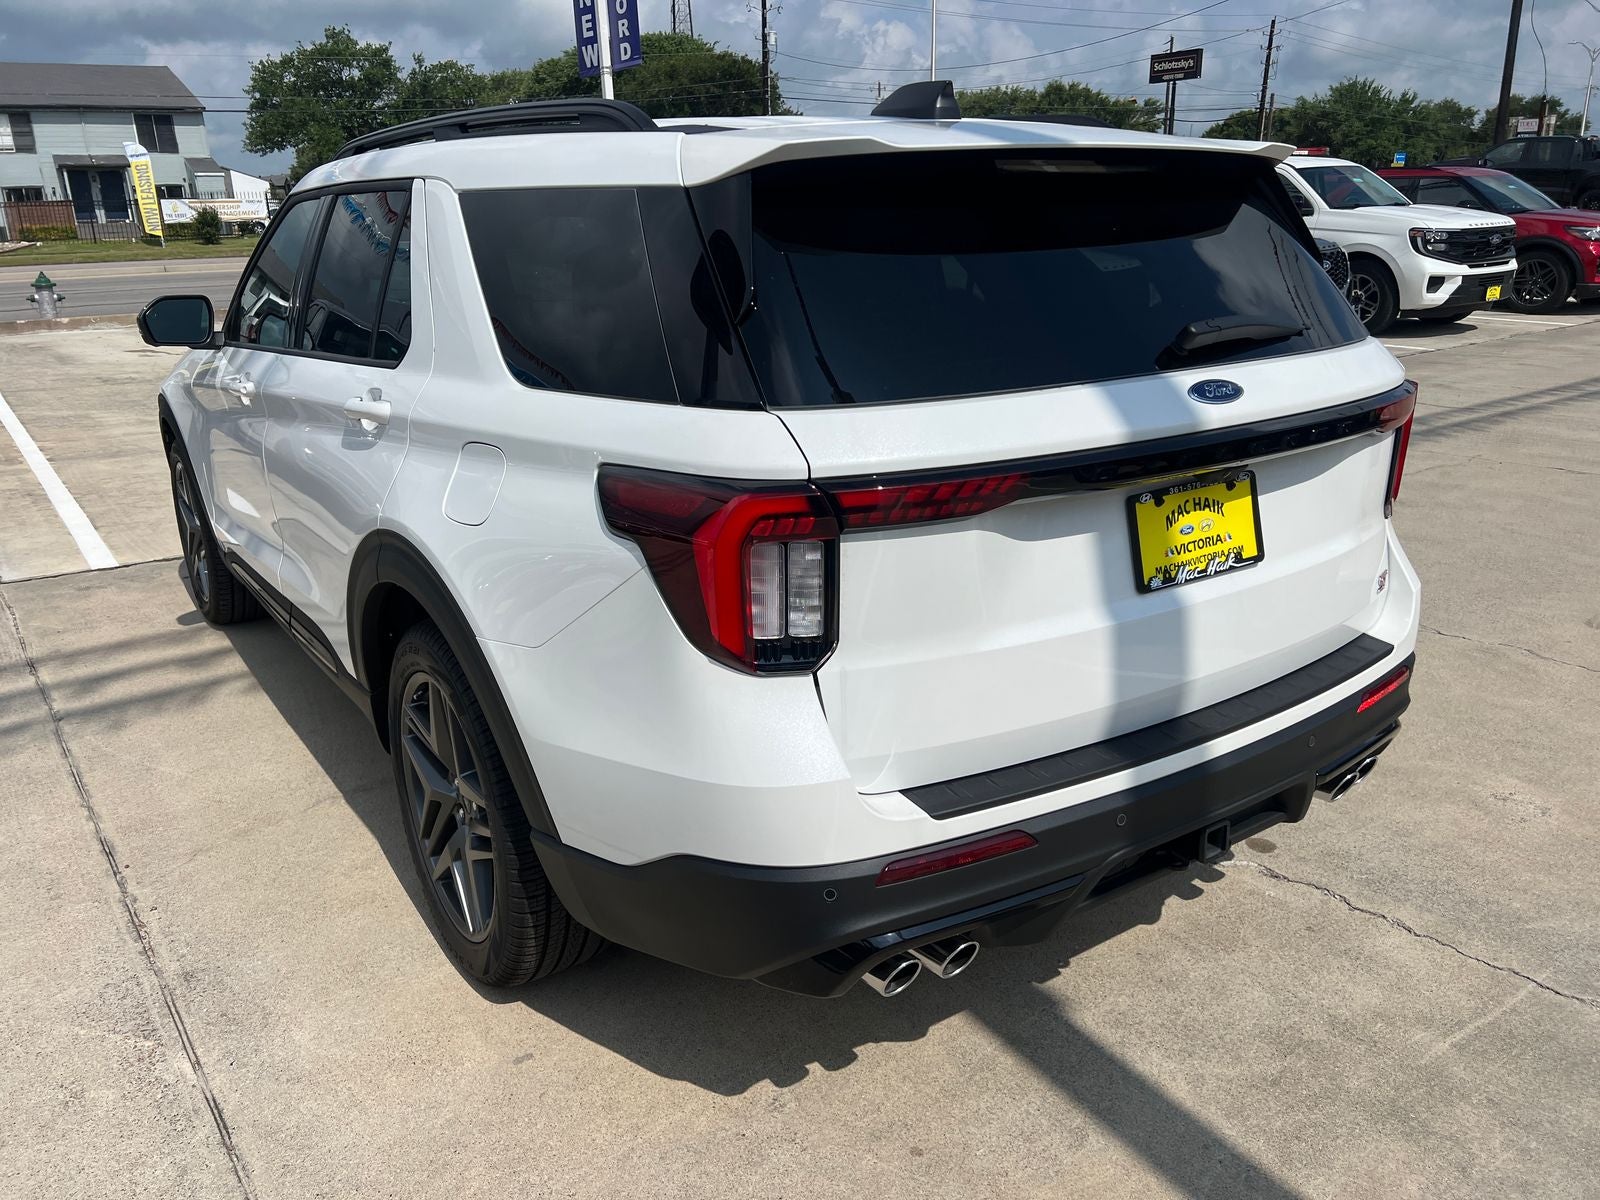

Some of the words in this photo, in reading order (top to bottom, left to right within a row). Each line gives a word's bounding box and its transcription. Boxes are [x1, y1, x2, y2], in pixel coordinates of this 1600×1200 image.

[1153, 58, 1194, 71] Schlotzsky's
[135, 163, 156, 206] LEASING
[143, 208, 161, 232] NOW
[1165, 499, 1191, 531] MAC
[1192, 496, 1225, 517] HAIK
[1174, 533, 1224, 556] VICTORIA
[1176, 563, 1206, 584] Mac
